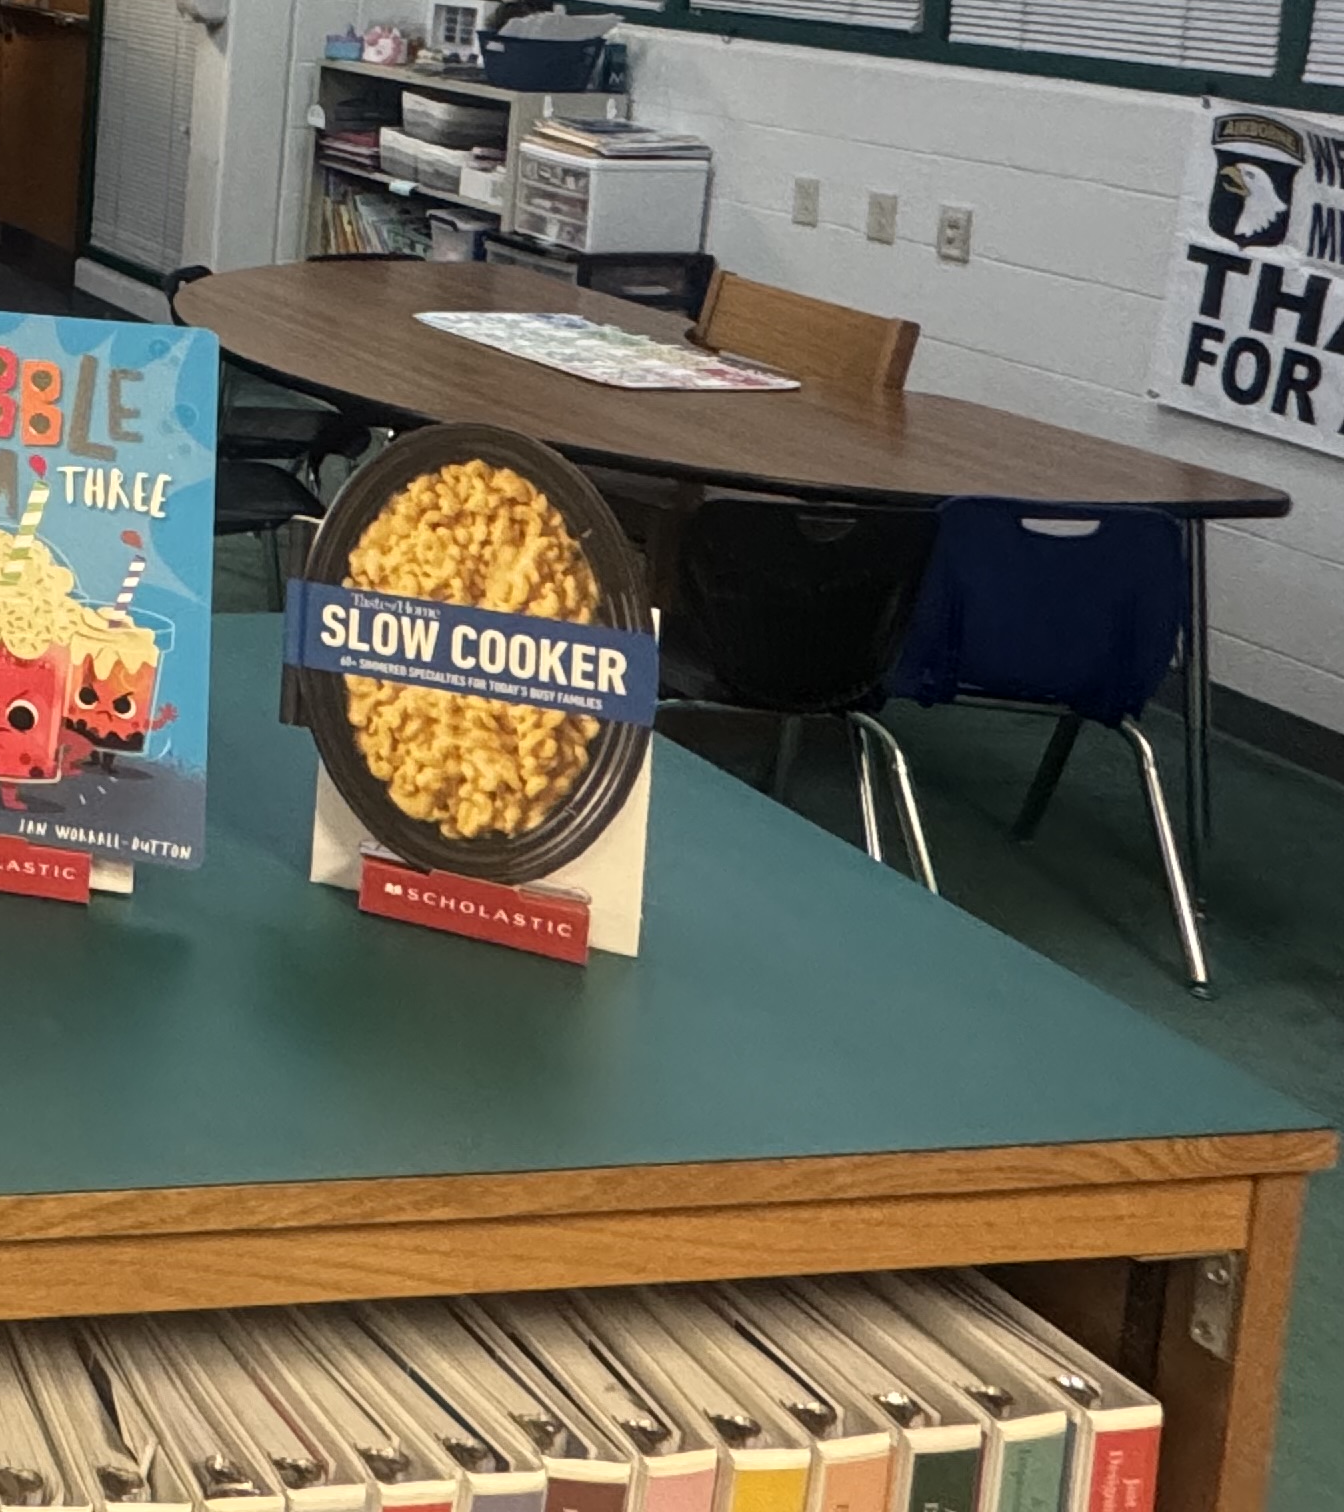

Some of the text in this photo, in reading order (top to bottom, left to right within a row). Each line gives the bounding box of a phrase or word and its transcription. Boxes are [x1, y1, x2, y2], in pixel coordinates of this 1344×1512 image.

[1181, 321, 1323, 425] FOR
[57, 466, 172, 518] THREE
[320, 604, 627, 696] SLOW COOKER
[55, 824, 192, 860] WORRALL-DUTTON
[406, 886, 574, 939] SCHOLASTIC
